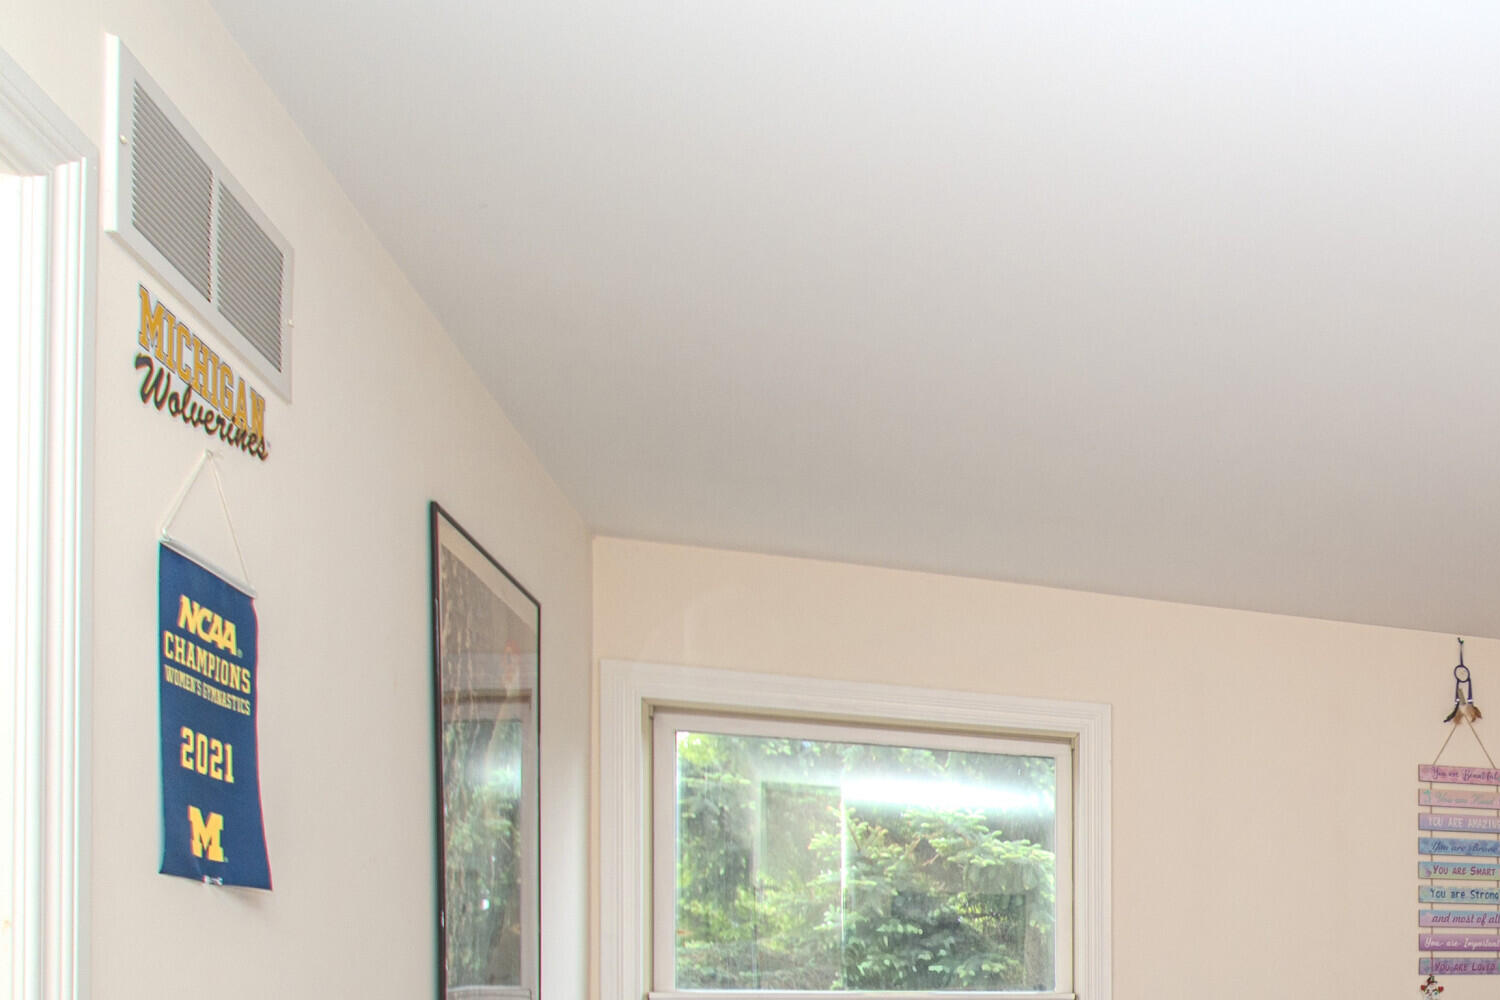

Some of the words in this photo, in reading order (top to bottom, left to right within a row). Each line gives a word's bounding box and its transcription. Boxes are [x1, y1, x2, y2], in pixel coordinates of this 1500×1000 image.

[138, 283, 265, 438] MICHIGAN
[134, 353, 268, 461] Wolverines
[178, 594, 238, 656] NCAA
[163, 630, 252, 695] CHAMPIONS
[164, 663, 202, 697] WOMEN'S
[202, 681, 252, 717] GYMNASTICS
[180, 726, 235, 784] 2021
[187, 804, 225, 863] M
